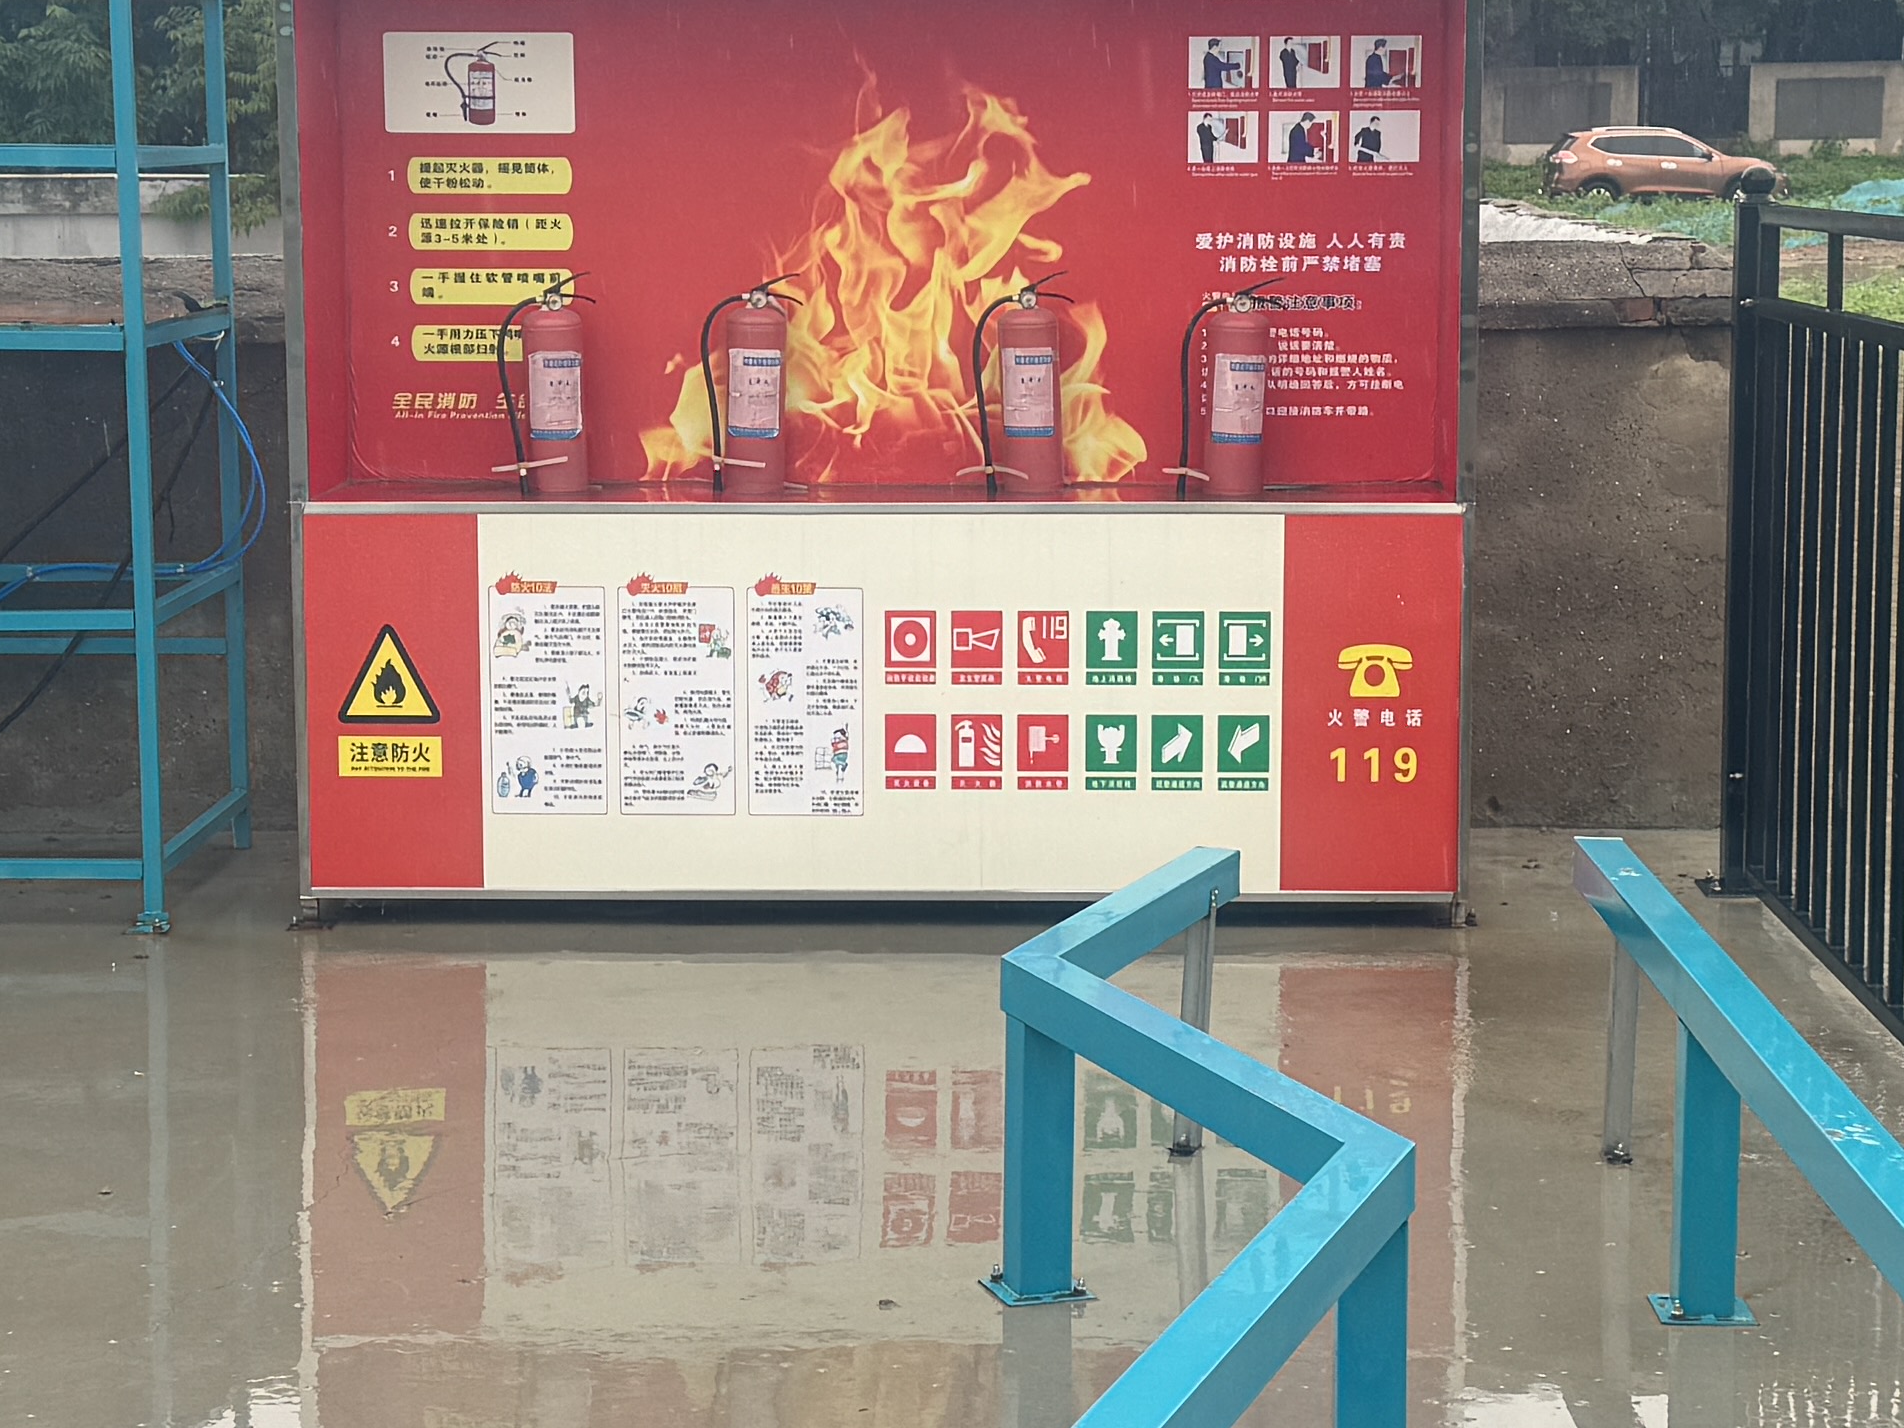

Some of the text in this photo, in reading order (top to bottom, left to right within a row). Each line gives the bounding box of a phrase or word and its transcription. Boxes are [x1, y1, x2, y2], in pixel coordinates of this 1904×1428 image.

[388, 170, 395, 182] 1
[388, 225, 398, 238] 2
[1196, 232, 1406, 250] 爱护消防设施 人人有责
[1219, 255, 1382, 273] 消防栓前严禁堵塞
[389, 280, 400, 293] 3
[391, 335, 400, 348] 4
[1042, 615, 1068, 640] 119
[1327, 708, 1423, 727] 火警电话
[350, 742, 431, 763] 注意防火
[1329, 746, 1418, 783] 119
